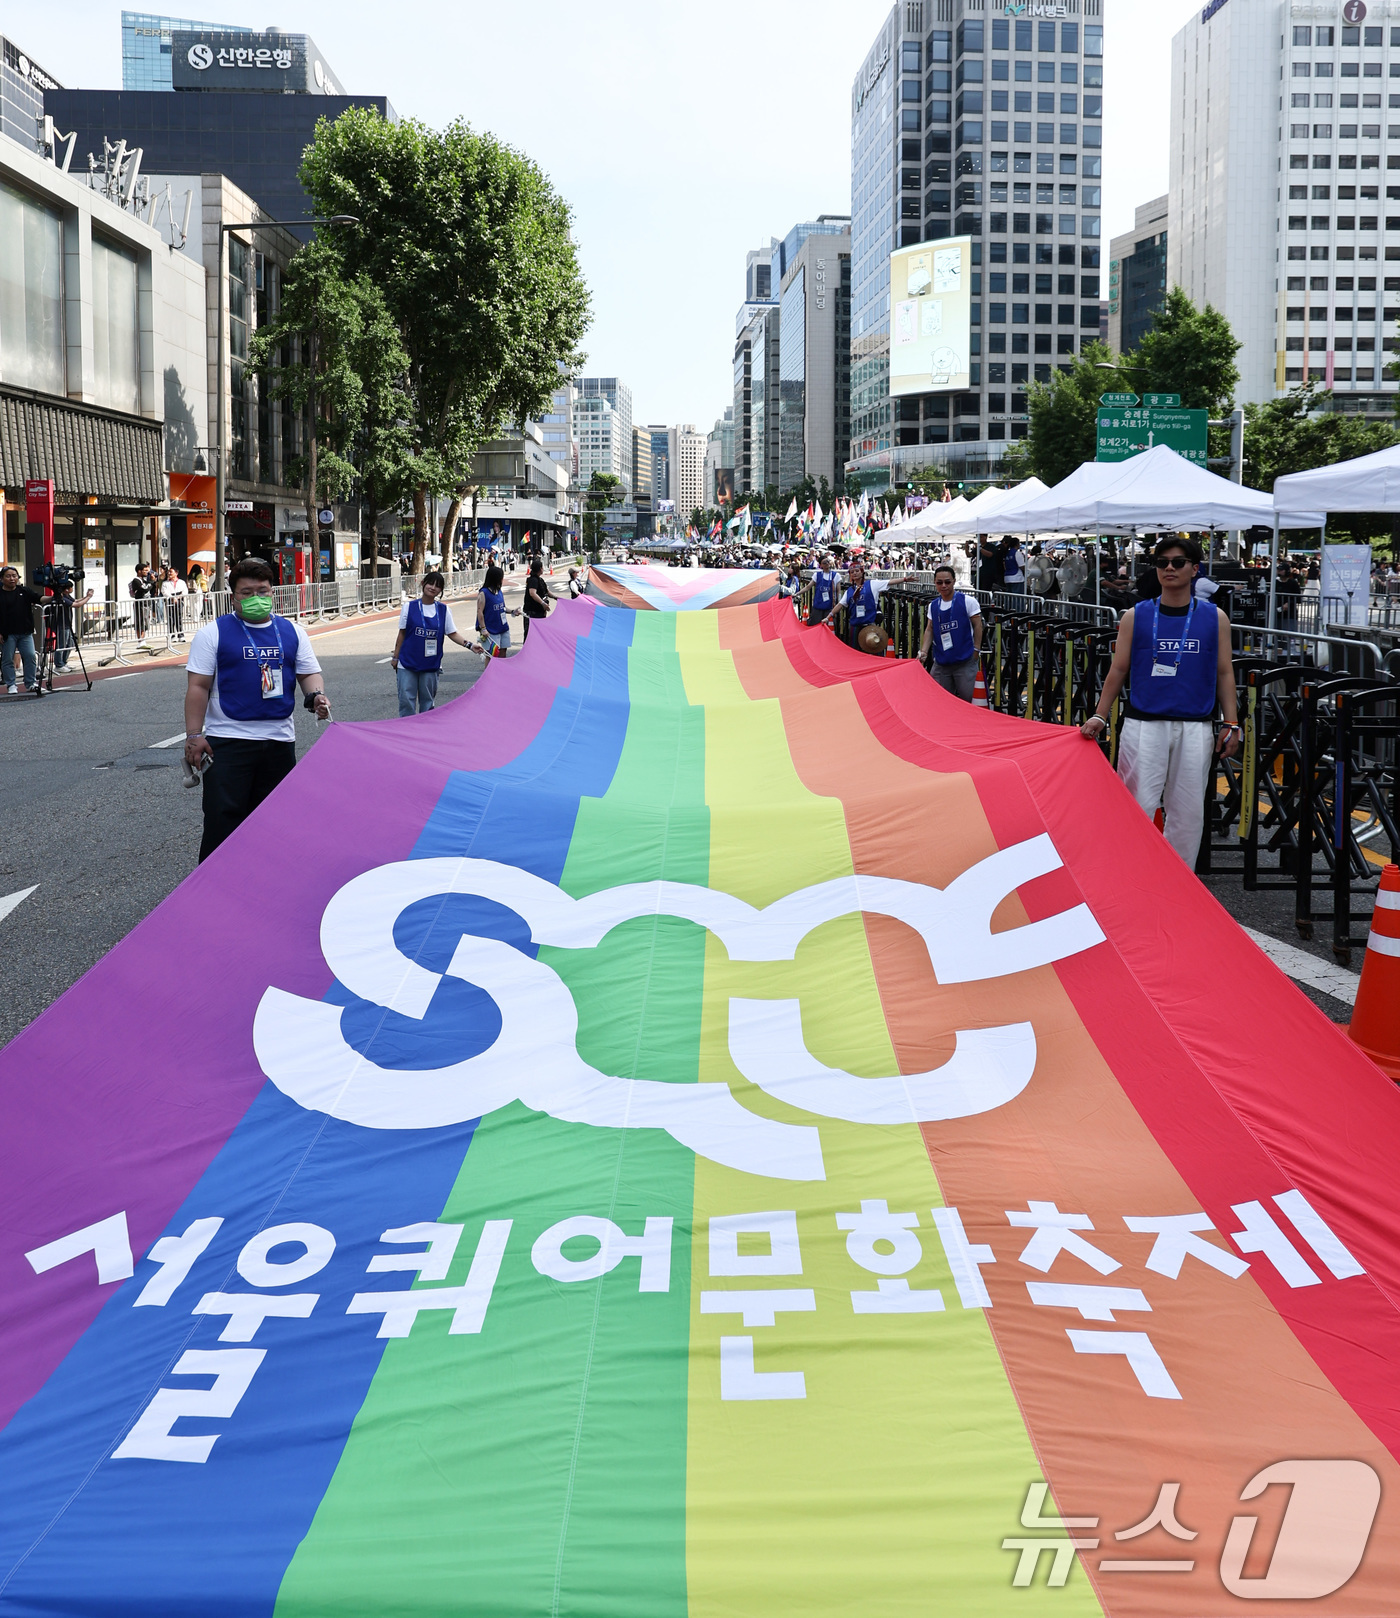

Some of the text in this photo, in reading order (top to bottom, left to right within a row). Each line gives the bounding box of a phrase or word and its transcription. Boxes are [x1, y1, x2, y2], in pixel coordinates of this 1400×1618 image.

[1028, 3, 1067, 18] iM뱅크
[216, 47, 292, 69] 신한은행
[815, 258, 826, 309] 동아빌딩
[1124, 410, 1150, 419] 숭례문
[1152, 413, 1191, 421] Sungnyemun
[1112, 418, 1150, 428] 을지로1가
[1152, 422, 1171, 430] Euljiro
[1099, 437, 1129, 447] 청계2가
[247, 648, 280, 657] SAFF
[24, 1188, 1367, 1464] 서울퀴어문화축제
